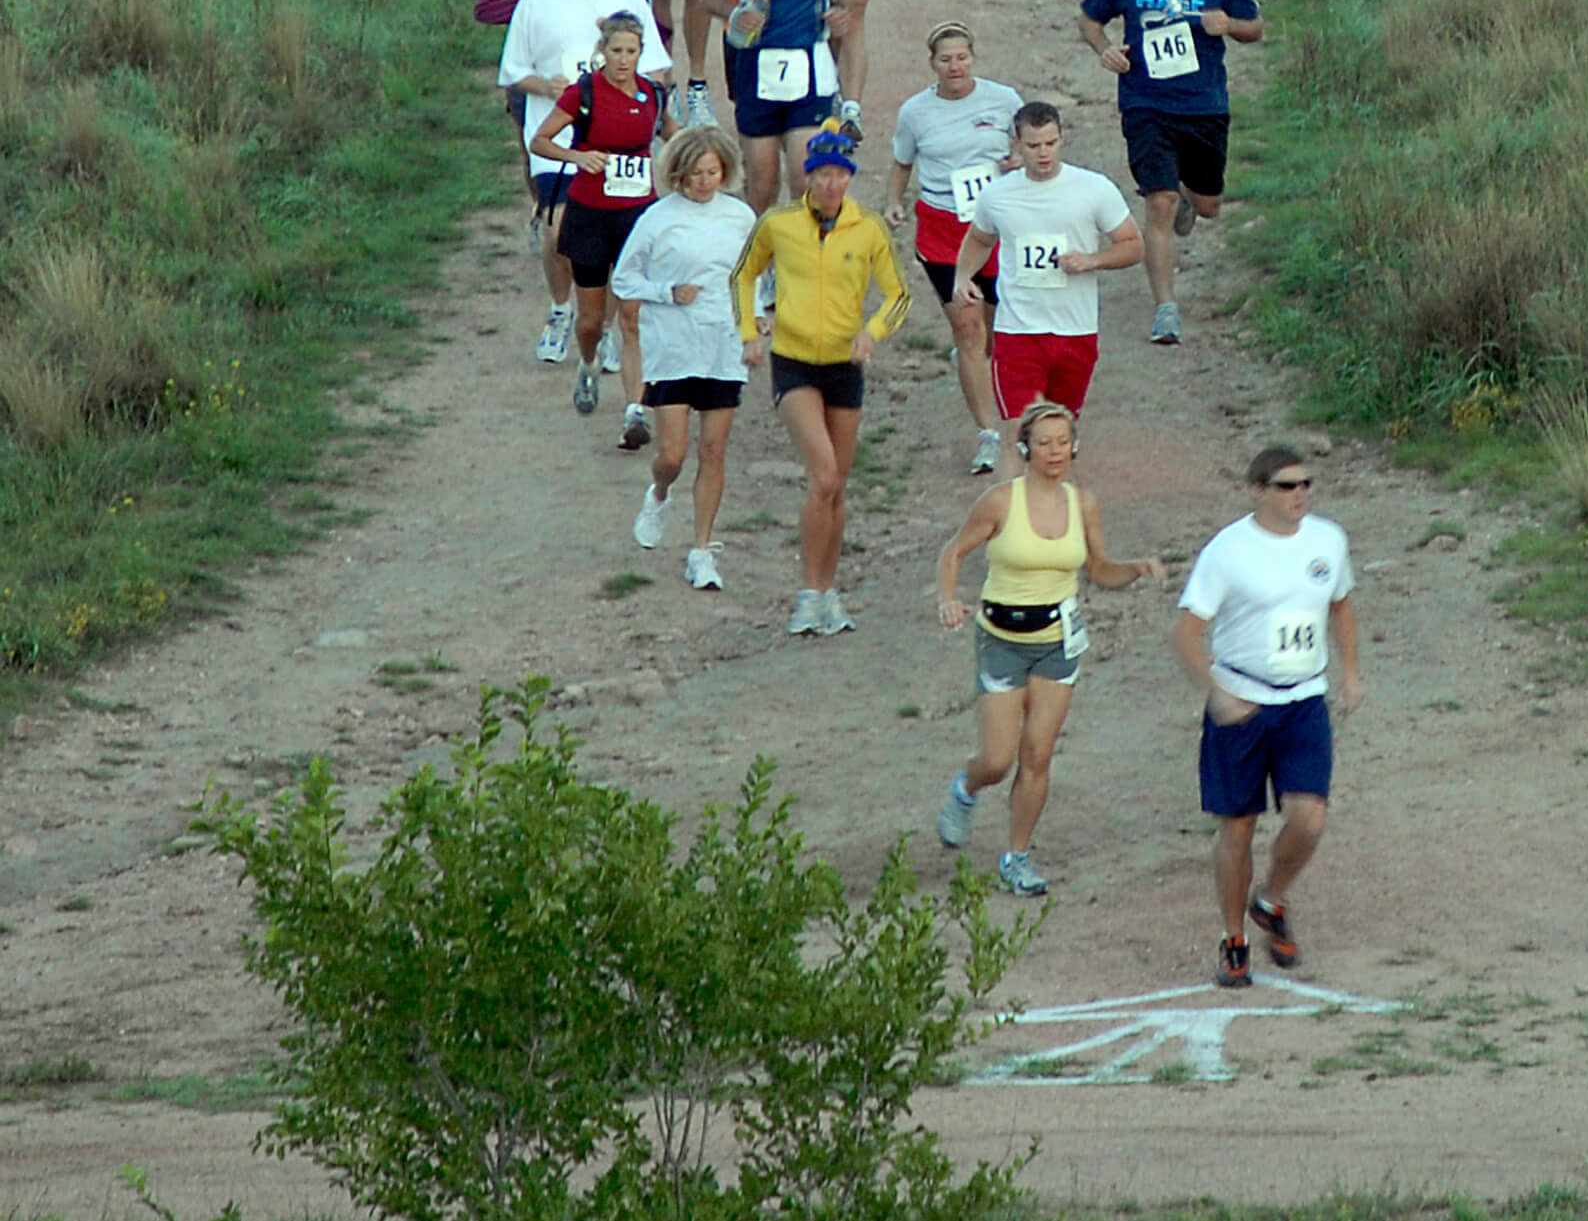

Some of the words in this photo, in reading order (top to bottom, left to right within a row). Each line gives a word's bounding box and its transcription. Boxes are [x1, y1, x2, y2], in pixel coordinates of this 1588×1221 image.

[1152, 34, 1187, 61] 146
[778, 60, 790, 82] 7
[616, 155, 644, 179] 164
[1023, 245, 1059, 269] 124
